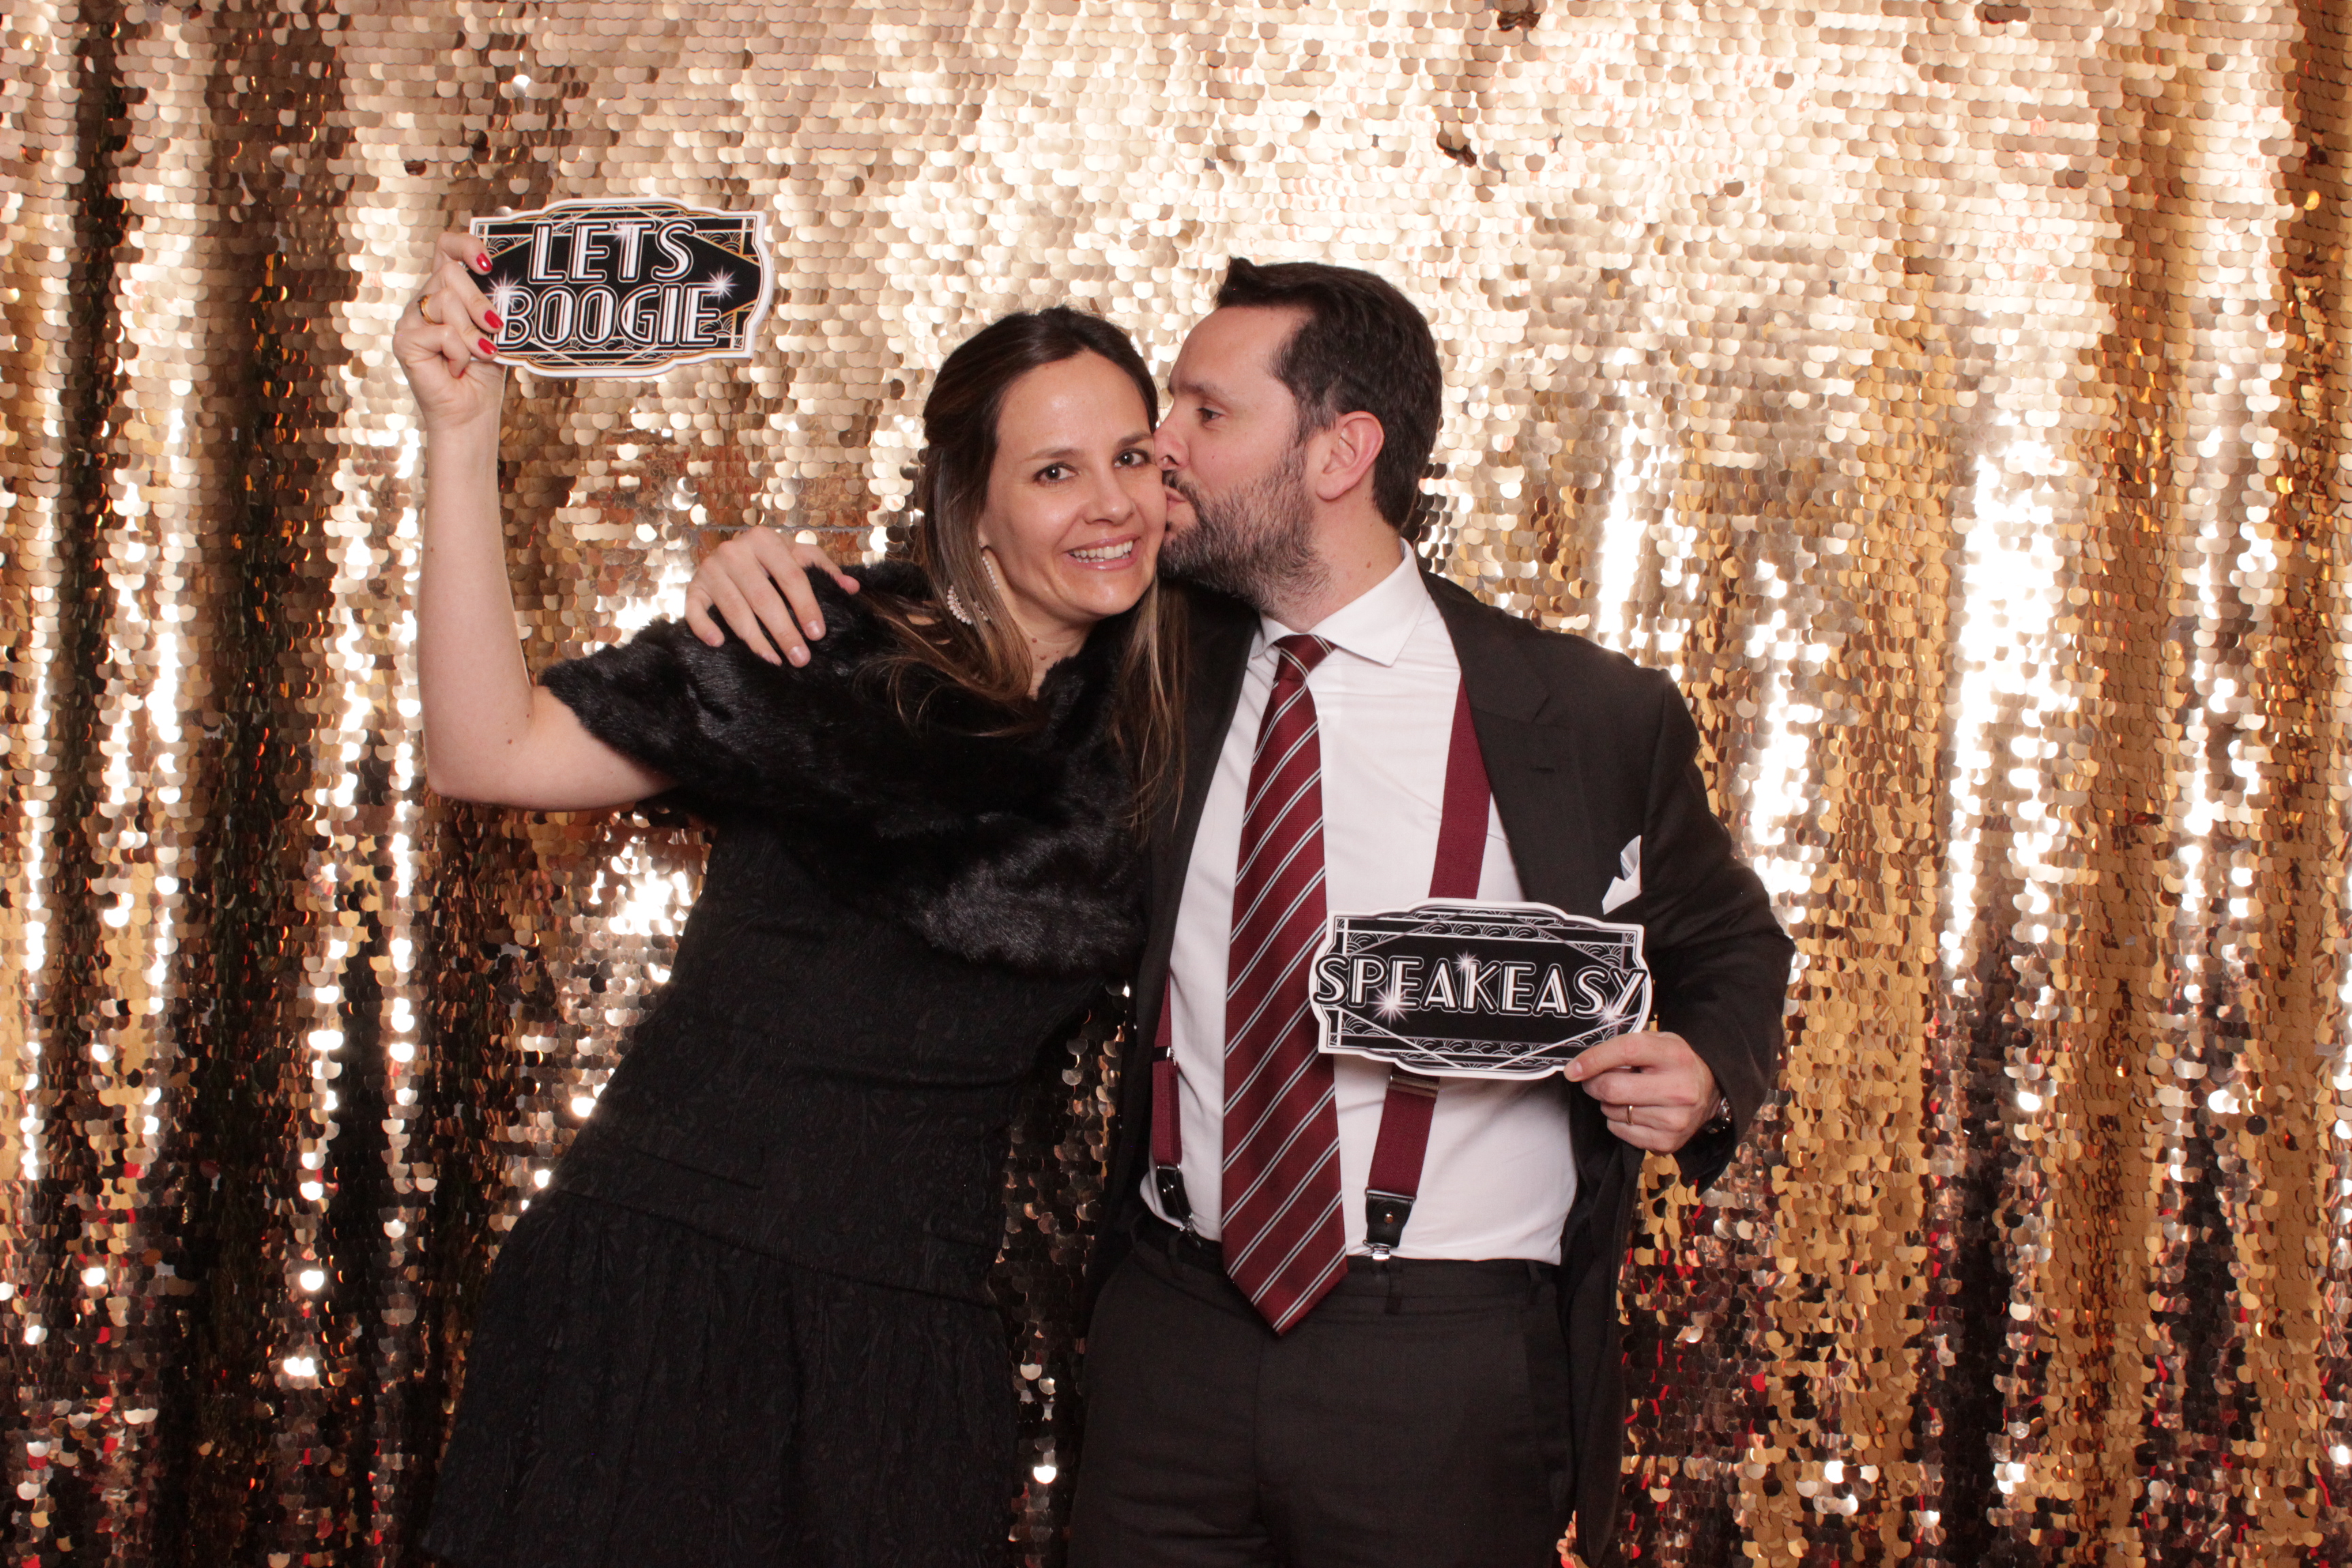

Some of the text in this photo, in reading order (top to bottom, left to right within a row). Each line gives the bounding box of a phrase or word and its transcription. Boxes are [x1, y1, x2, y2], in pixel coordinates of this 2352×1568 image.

[530, 220, 696, 282] LETS
[495, 284, 723, 347] BOOGIE
[1313, 954, 1648, 1018] SPEAKEASY
